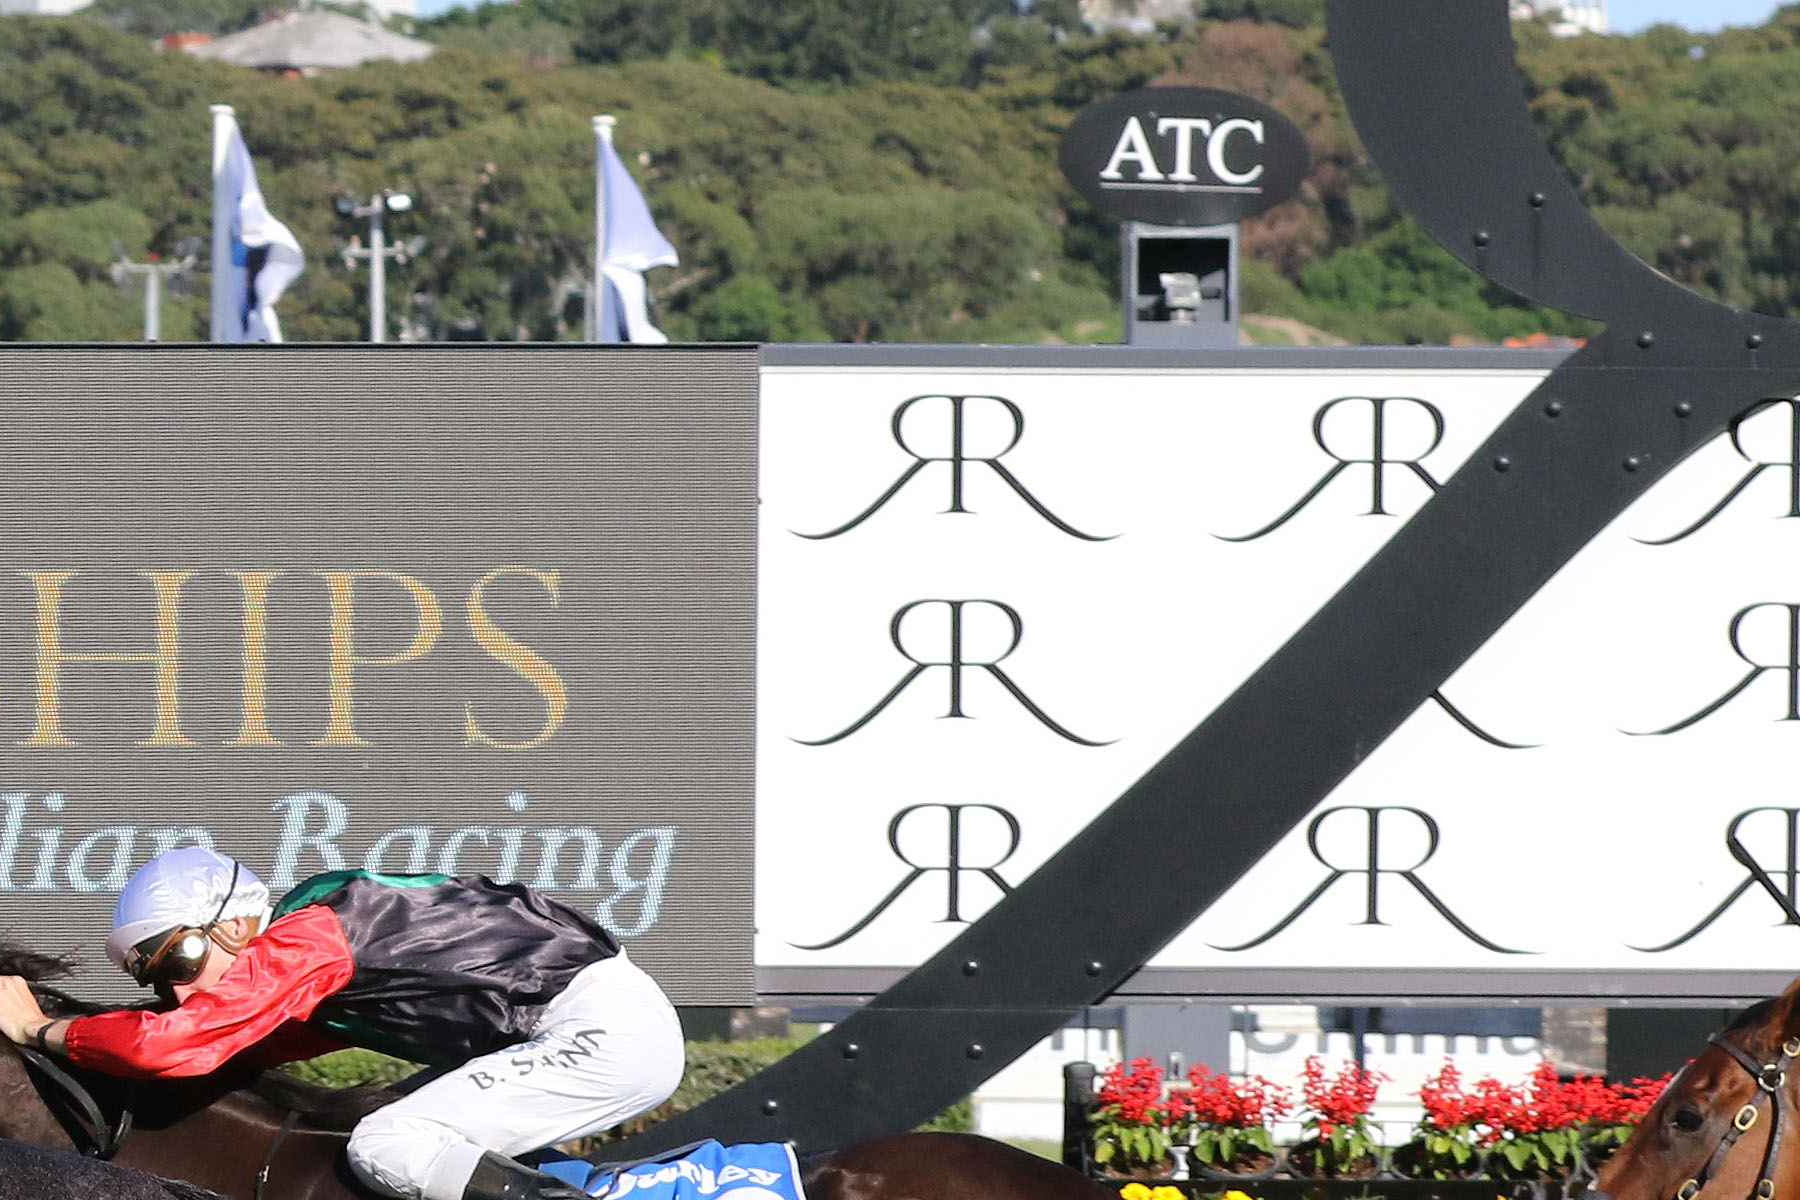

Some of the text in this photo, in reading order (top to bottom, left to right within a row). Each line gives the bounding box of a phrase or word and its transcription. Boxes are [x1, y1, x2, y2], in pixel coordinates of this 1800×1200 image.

[1099, 115, 1264, 185] ATC
[263, 790, 678, 937] Racing
[468, 1070, 506, 1091] B.
